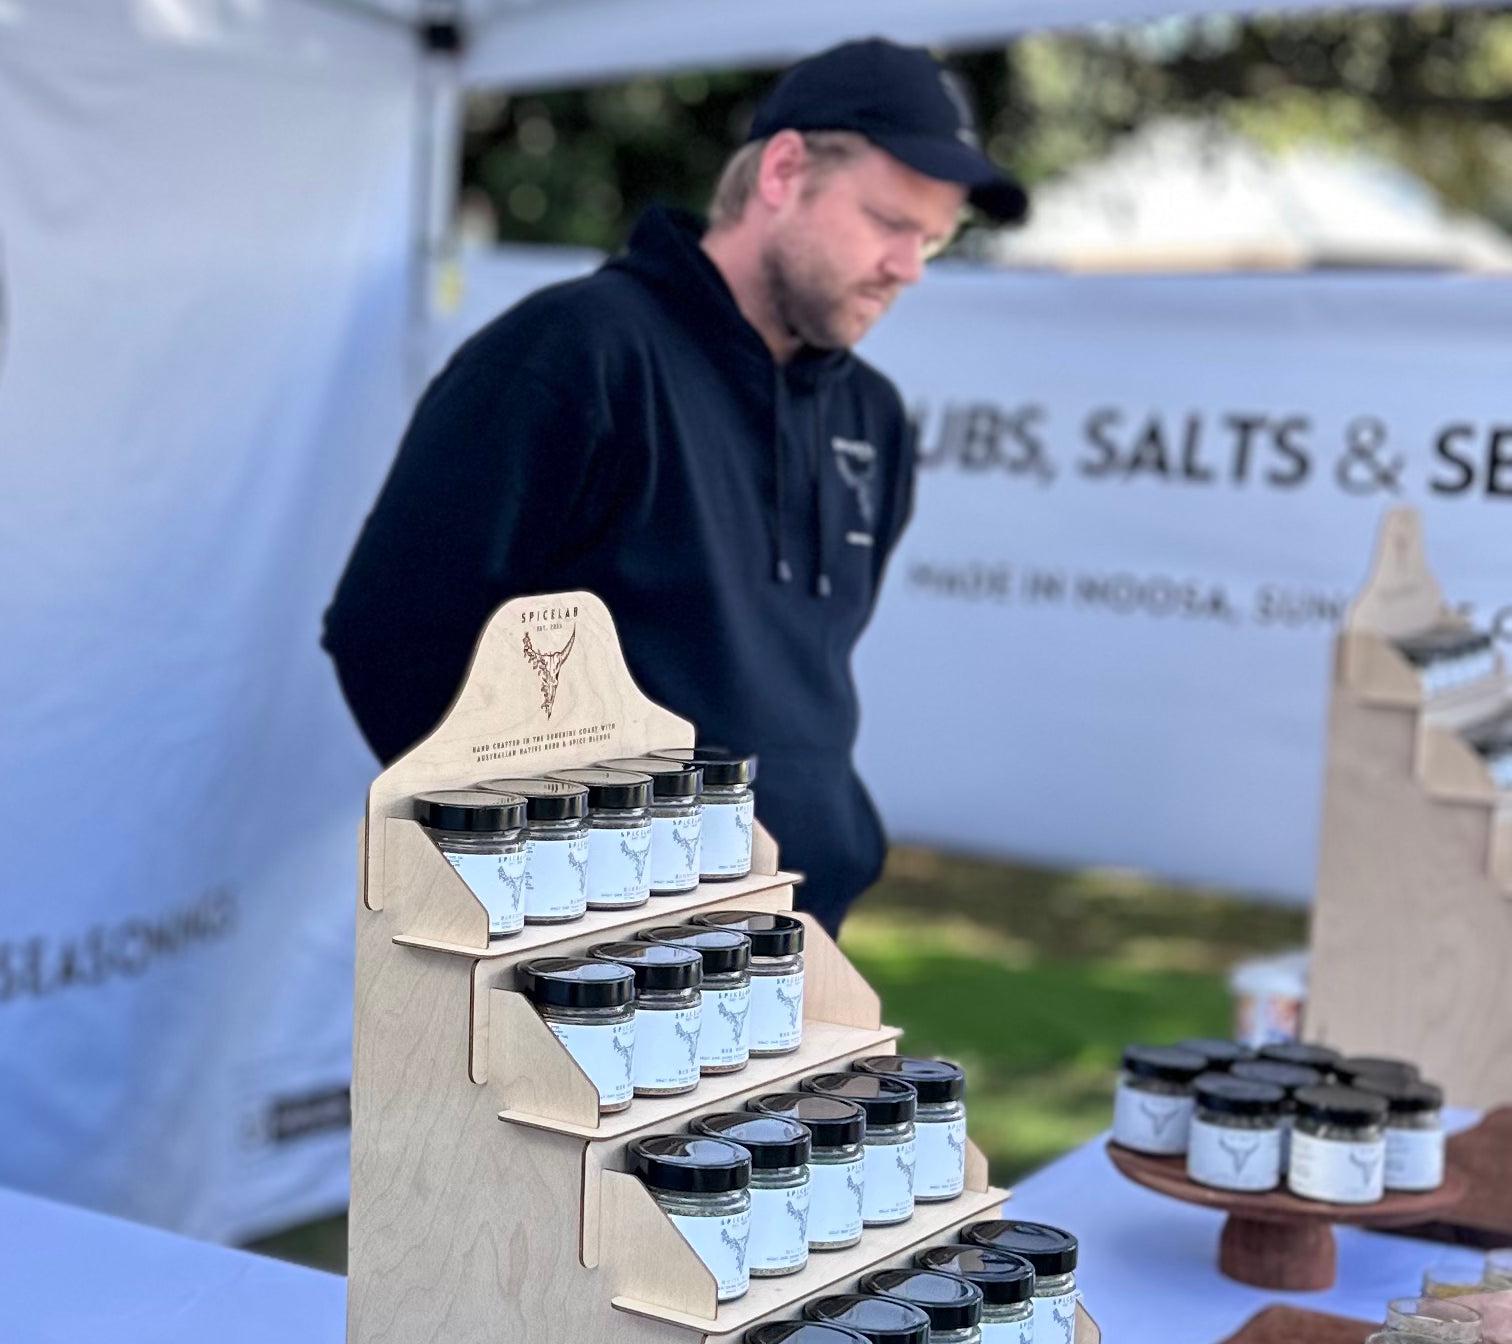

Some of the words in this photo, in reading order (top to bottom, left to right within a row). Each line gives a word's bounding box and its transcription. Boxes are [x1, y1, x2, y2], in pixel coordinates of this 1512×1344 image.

[915, 400, 1056, 488] UBS,
[1078, 408, 1313, 491] SALTS
[1335, 417, 1406, 495] &
[521, 606, 578, 623] SPICELAB
